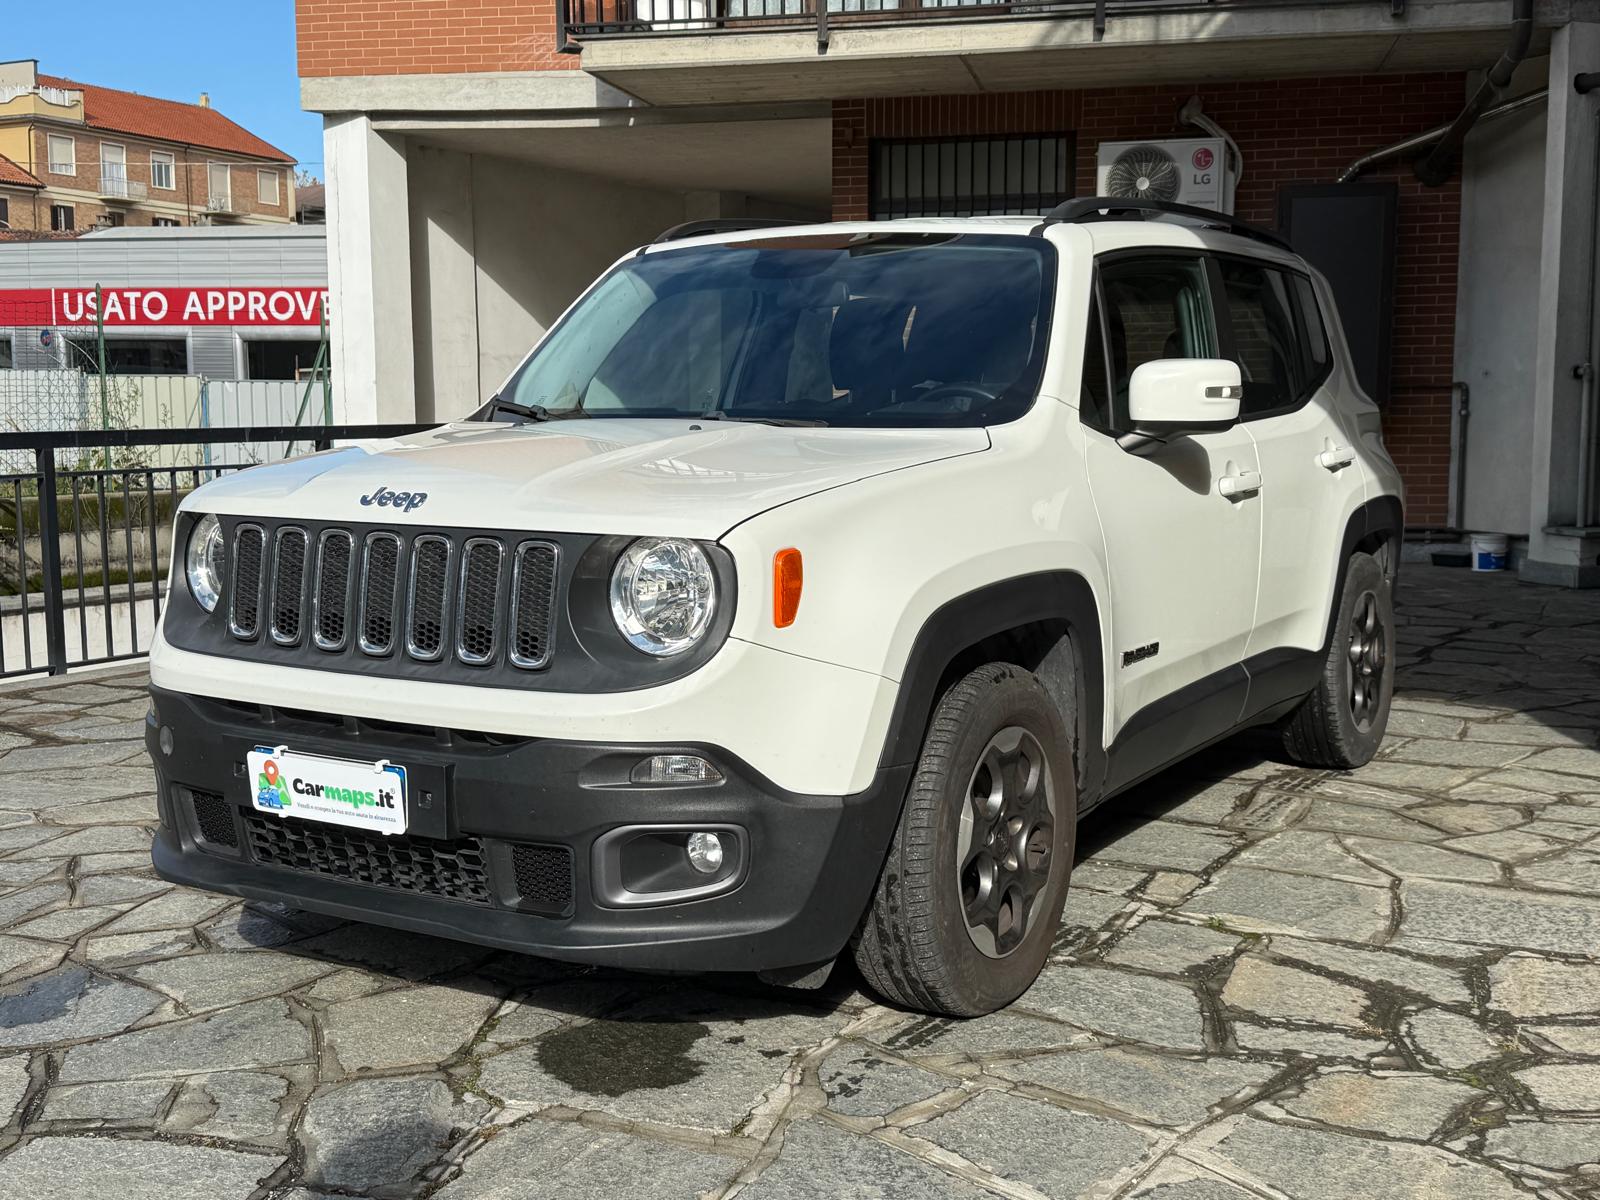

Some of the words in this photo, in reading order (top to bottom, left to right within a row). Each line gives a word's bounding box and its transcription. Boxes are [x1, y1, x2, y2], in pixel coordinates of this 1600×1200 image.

[1193, 174, 1211, 185] LG
[63, 291, 168, 321] USATO
[360, 487, 428, 512] Jeep
[293, 778, 395, 808] Carmaps.it
